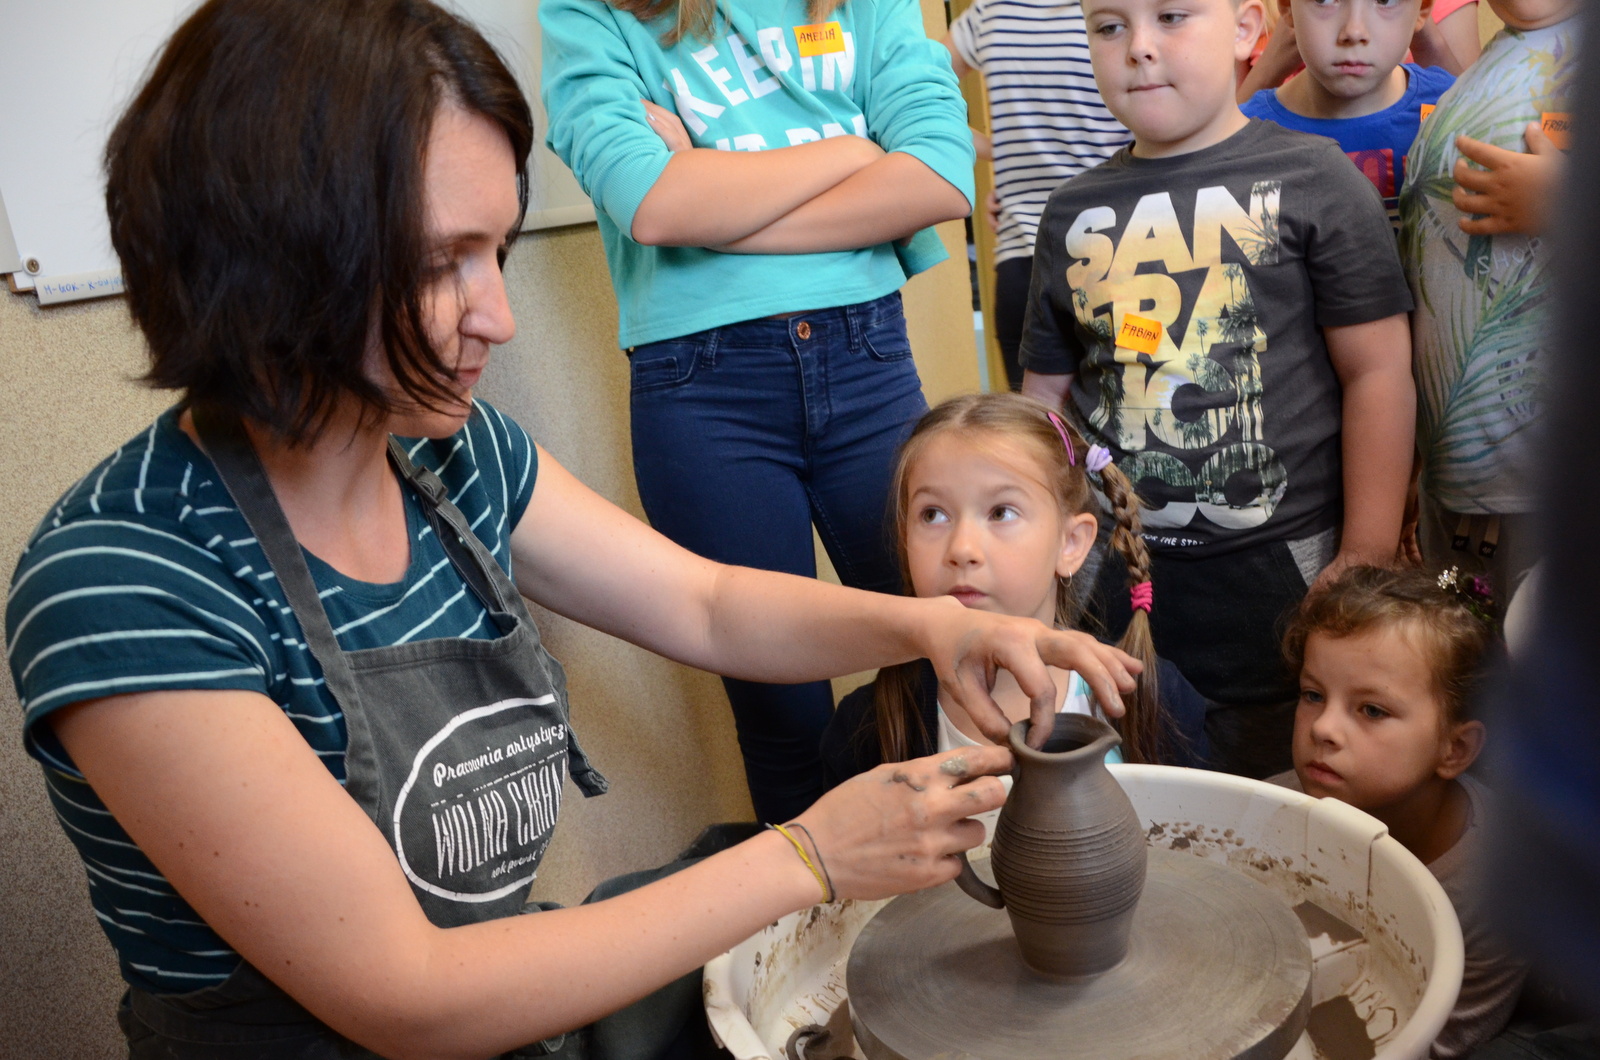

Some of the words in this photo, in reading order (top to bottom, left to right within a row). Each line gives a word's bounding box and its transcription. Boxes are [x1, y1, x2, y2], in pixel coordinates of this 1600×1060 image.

[799, 28, 836, 43] AMELIA
[662, 27, 793, 137] KEEP
[1065, 180, 1282, 285] SAN
[1122, 323, 1159, 342] FABIAN
[1160, 536, 1178, 547] THE
[433, 746, 503, 788] Pracownia
[506, 723, 567, 758] artystycz
[432, 789, 508, 879] WOLNA
